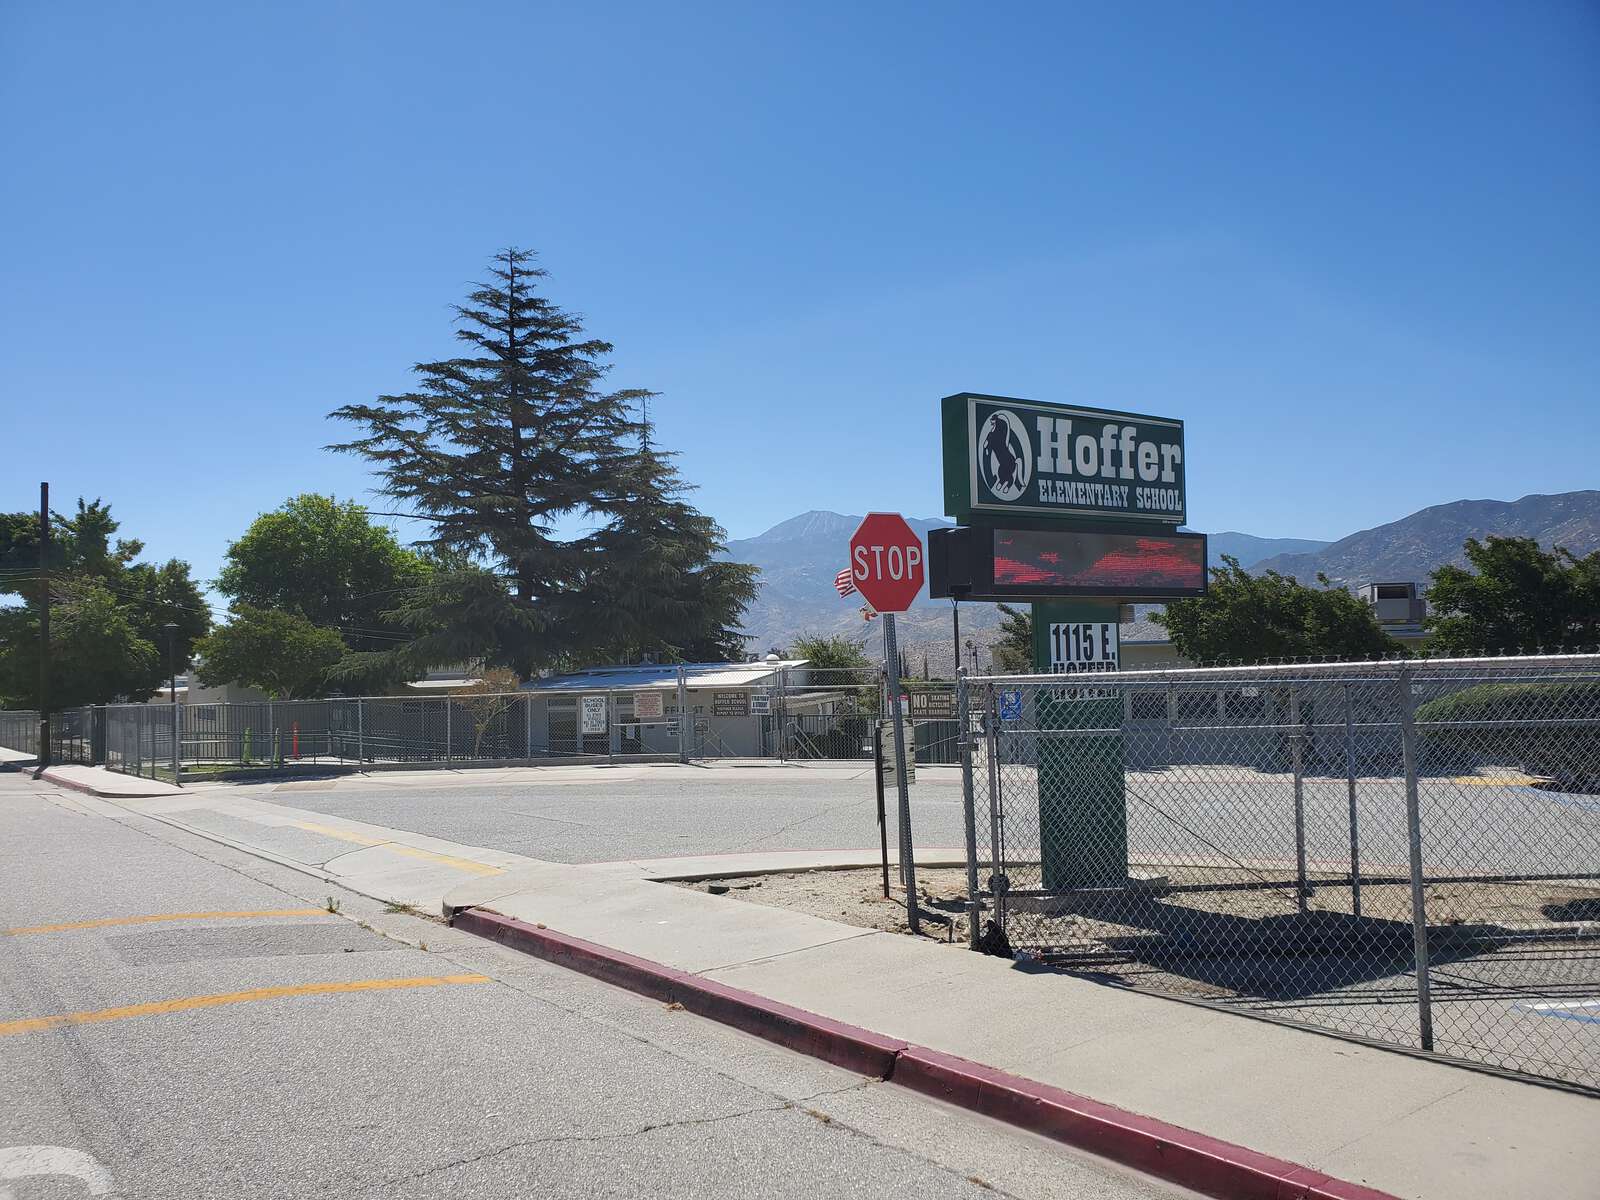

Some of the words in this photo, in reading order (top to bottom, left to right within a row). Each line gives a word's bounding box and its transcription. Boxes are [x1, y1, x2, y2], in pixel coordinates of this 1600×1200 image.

[1036, 416, 1182, 483] Hoffer
[1038, 479, 1129, 508] ELEMENTARY
[1135, 486, 1183, 511] SCHOOL
[854, 545, 921, 580] STOP
[1052, 624, 1095, 662] 1115
[913, 695, 928, 708] NO
